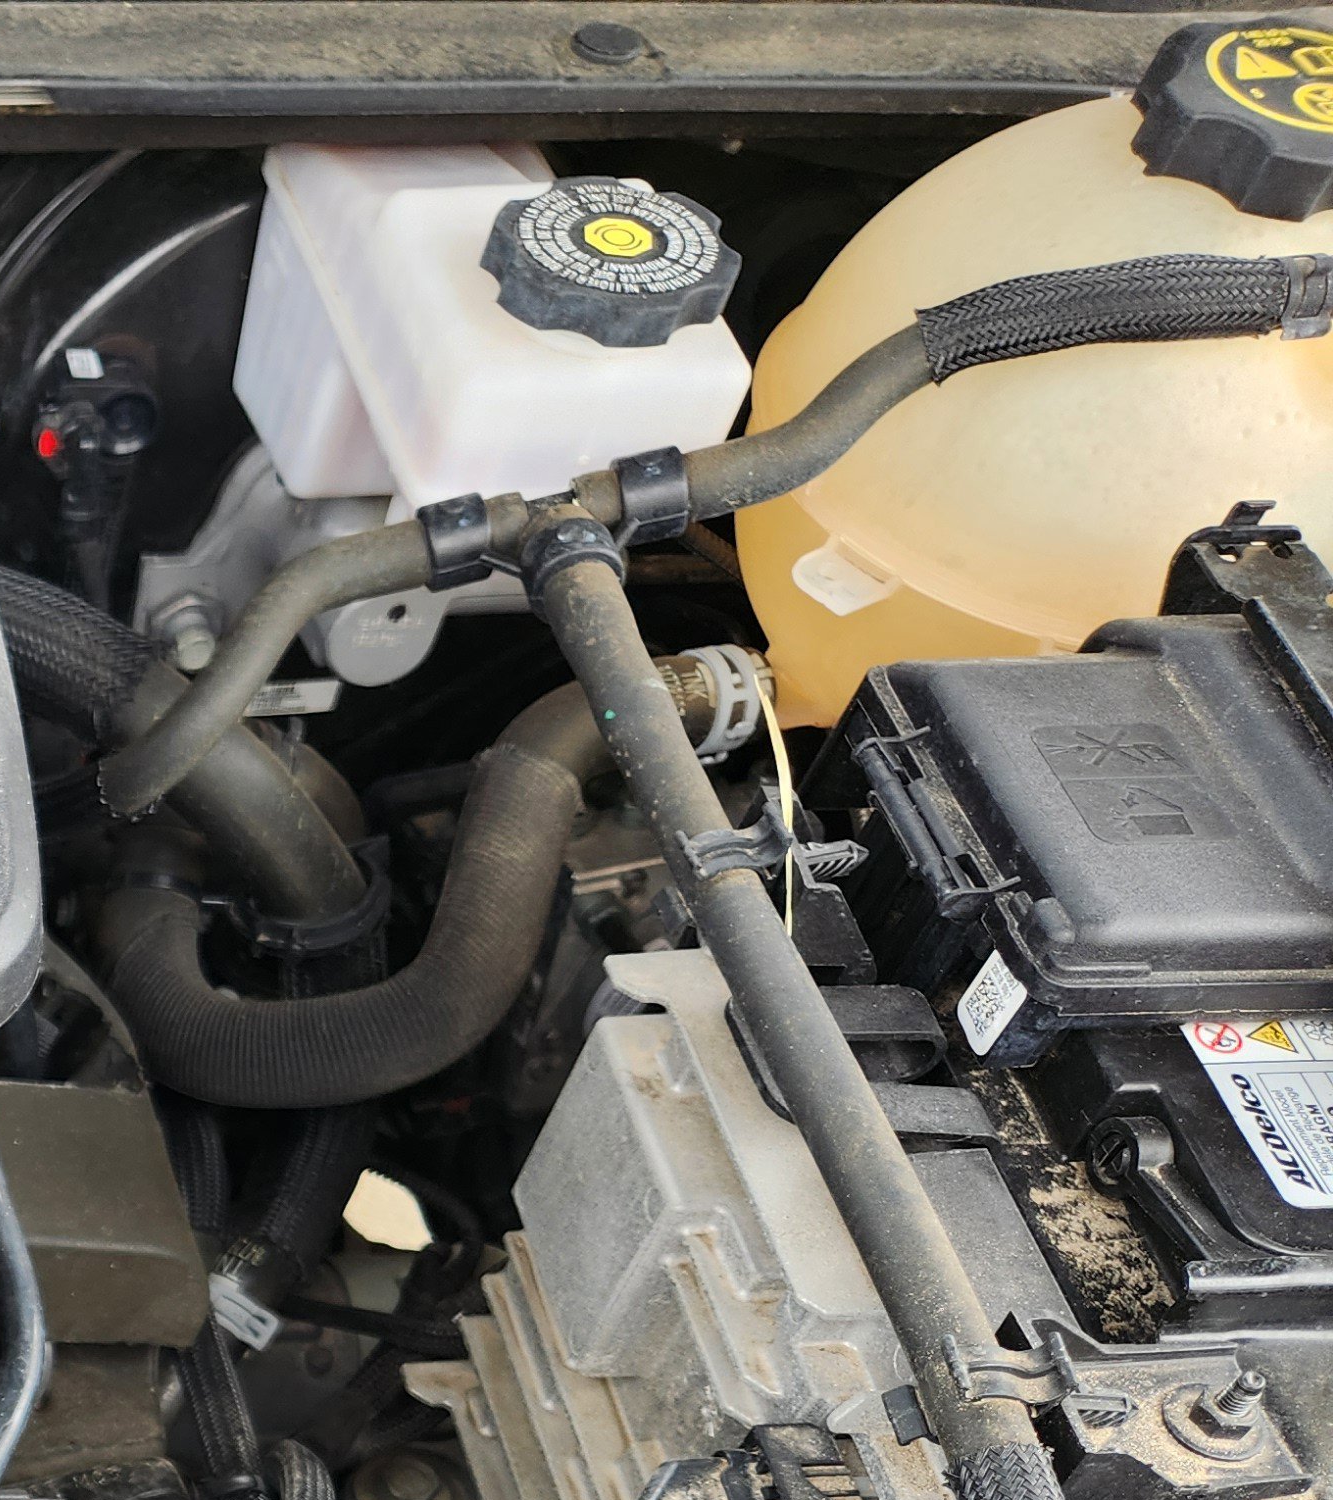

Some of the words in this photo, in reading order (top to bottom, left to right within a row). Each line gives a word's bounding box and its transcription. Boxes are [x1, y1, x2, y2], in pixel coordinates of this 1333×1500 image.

[1231, 1073, 1315, 1190] ACDelco
[1271, 1088, 1294, 1117] Model
[1289, 1119, 1332, 1177] Replacement
